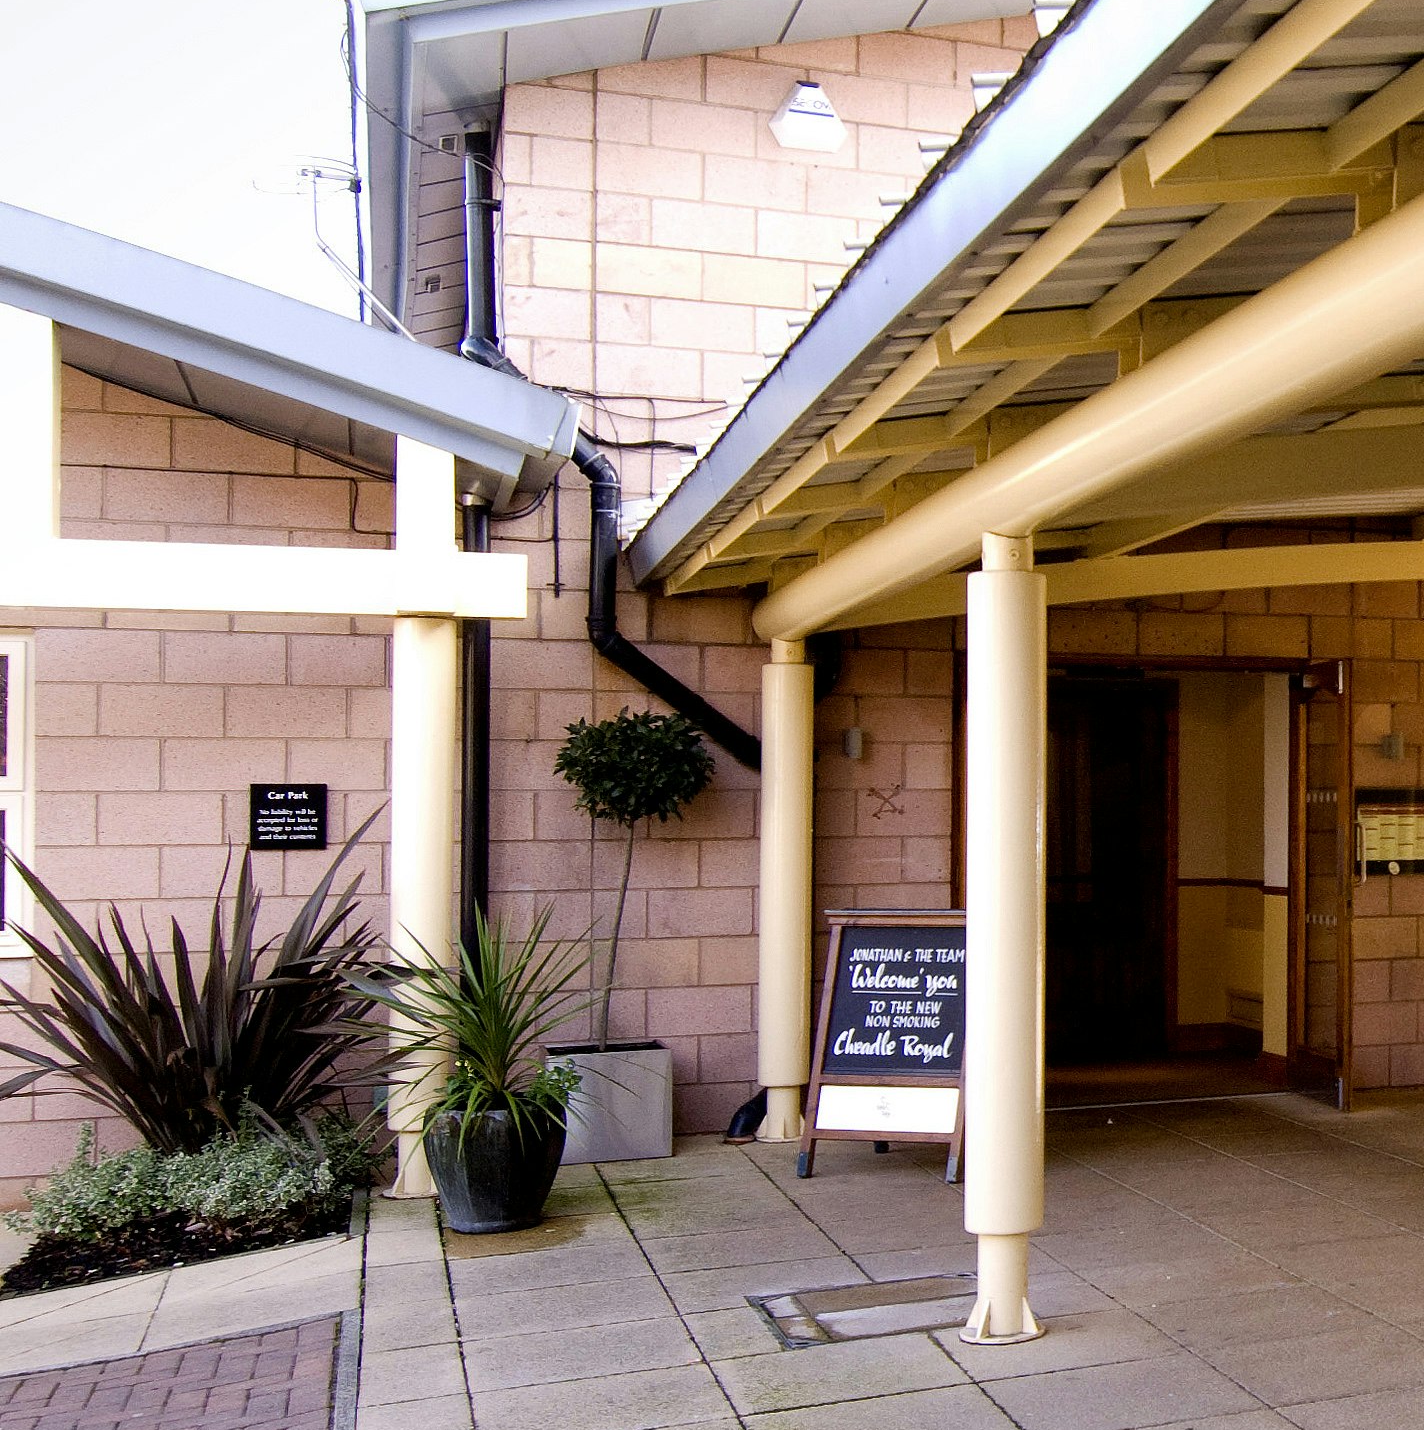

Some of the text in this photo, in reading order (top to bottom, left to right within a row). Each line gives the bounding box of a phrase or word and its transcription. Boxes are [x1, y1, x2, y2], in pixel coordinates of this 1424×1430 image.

[267, 790, 309, 800] Car Park
[849, 948, 903, 962] JONATHAN
[915, 948, 934, 963] THE
[936, 949, 966, 963] TEAM
[925, 974, 958, 998] you
[869, 1000, 942, 1014] TO THE NEW
[865, 1015, 941, 1028] NON SMOKING
[833, 1027, 954, 1064] Cheadle Royal
